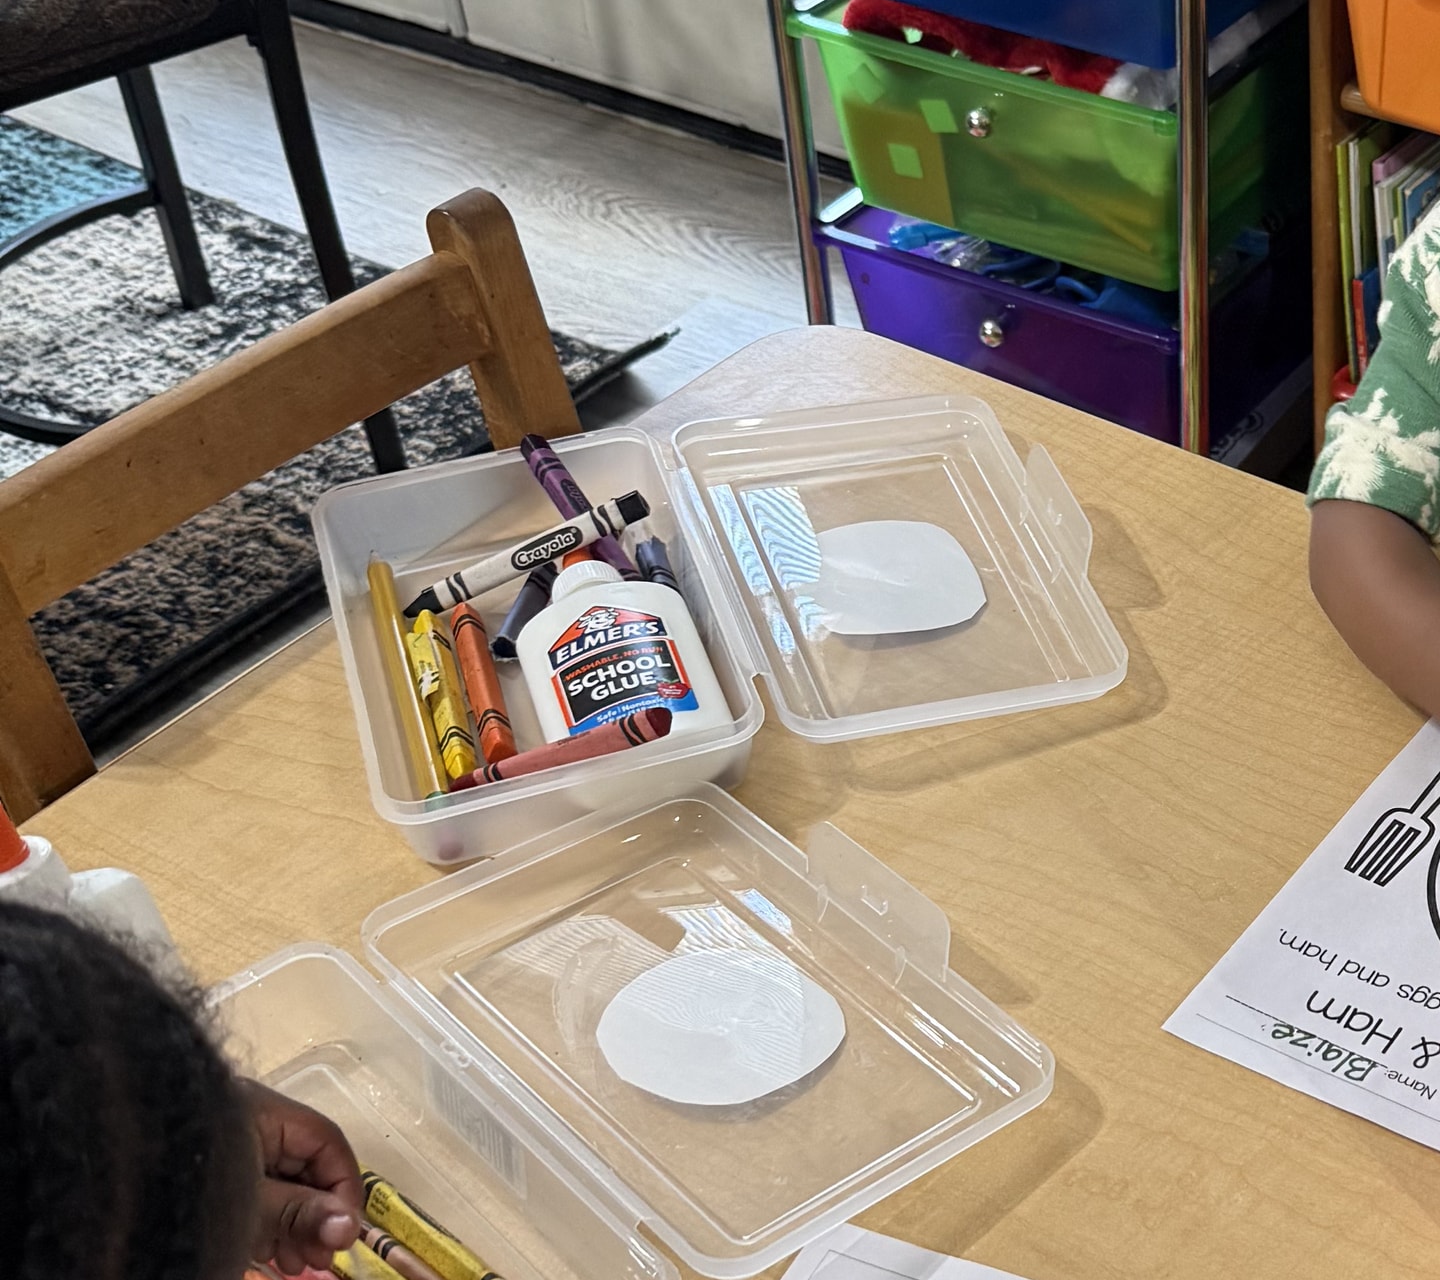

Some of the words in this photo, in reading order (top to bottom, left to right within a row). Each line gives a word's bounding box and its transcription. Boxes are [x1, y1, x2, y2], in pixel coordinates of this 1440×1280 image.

[515, 530, 576, 564] Crayola
[556, 621, 659, 664] ELMER'S
[624, 648, 639, 657] NO
[568, 655, 671, 696] SCHOOL
[590, 671, 657, 701] GLUE
[597, 709, 618, 722] Safe
[1278, 927, 1341, 973] ham.
[1338, 960, 1391, 992] and
[1305, 989, 1403, 1055] Ham
[1384, 1067, 1438, 1101] Name:
